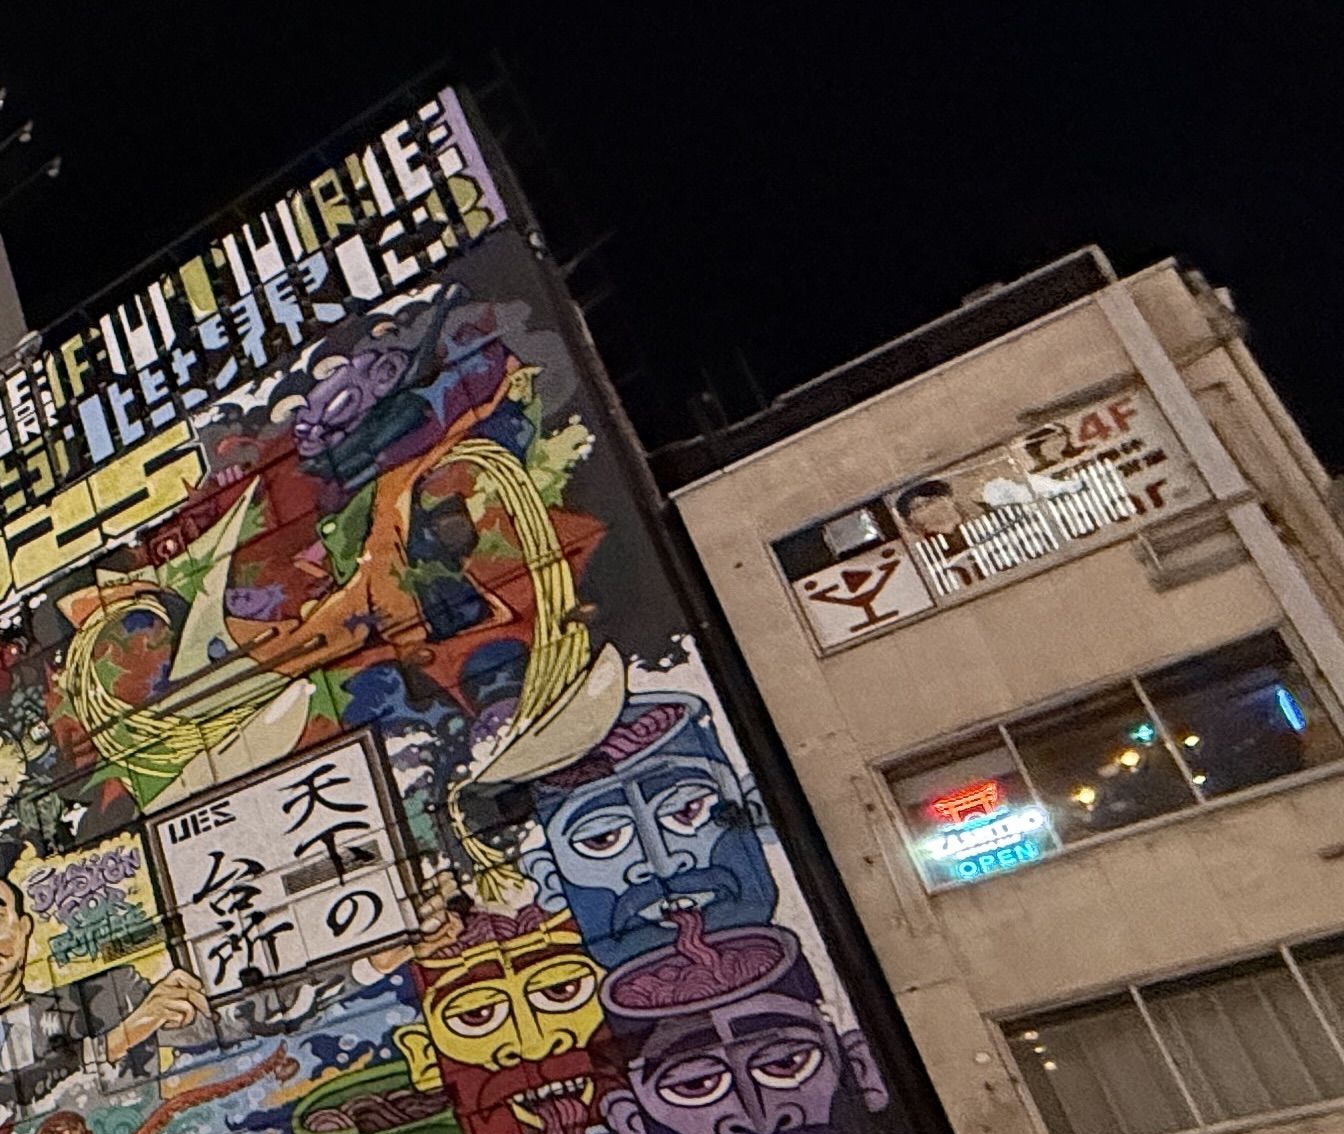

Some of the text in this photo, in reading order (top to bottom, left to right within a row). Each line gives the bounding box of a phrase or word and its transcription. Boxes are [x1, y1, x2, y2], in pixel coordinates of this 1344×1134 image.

[1078, 397, 1138, 443] 4F
[278, 763, 383, 938] 天下の
[958, 840, 1040, 878] OPEN
[192, 851, 295, 986] 台所
